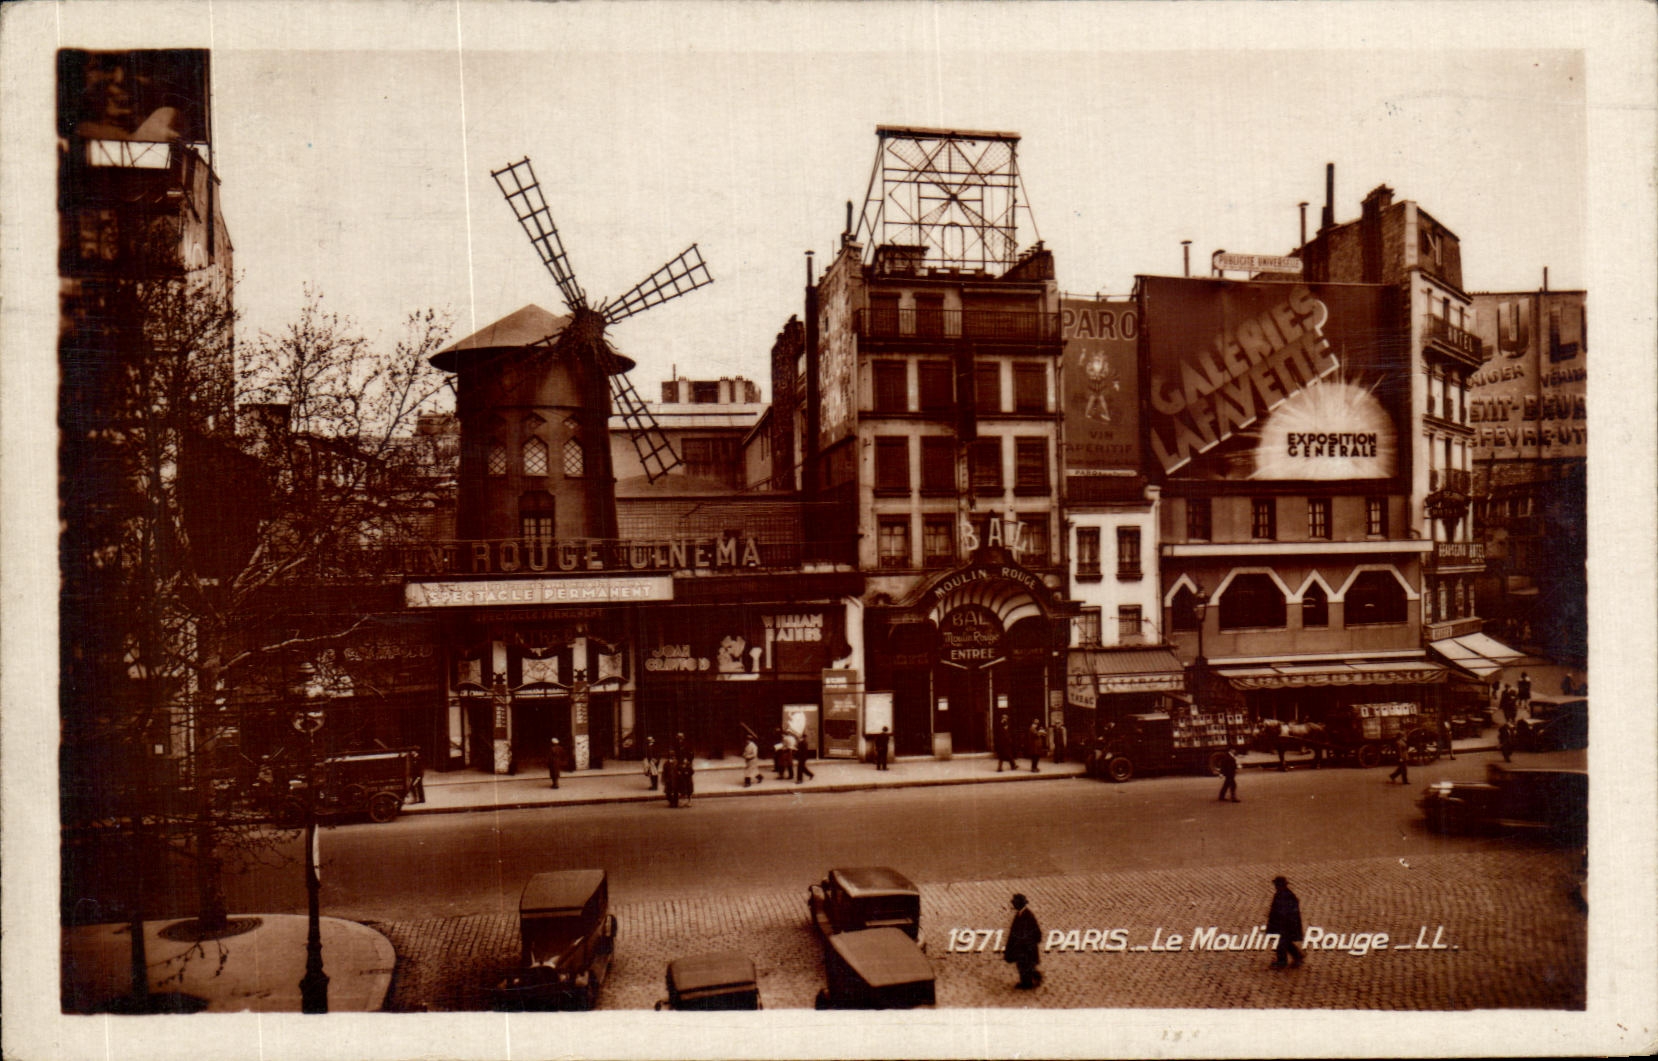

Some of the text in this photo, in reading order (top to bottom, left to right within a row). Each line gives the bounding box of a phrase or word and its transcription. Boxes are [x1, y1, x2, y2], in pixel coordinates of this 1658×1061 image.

[1448, 326, 1472, 353] HOTEL
[1150, 285, 1328, 416] GALERIES
[1150, 330, 1339, 475] LAFAYETTE
[1089, 431, 1113, 439] VIN
[1287, 432, 1377, 446] EXPOSITION
[1287, 445, 1377, 457] GENERALE
[961, 518, 1027, 551] BAL
[934, 567, 1036, 598] MOULIN ROUGE
[429, 585, 653, 604] SPECTACLE PERMANENT
[761, 613, 823, 628] WILLIAM
[952, 611, 992, 626] BAL
[651, 643, 690, 658] JOAN
